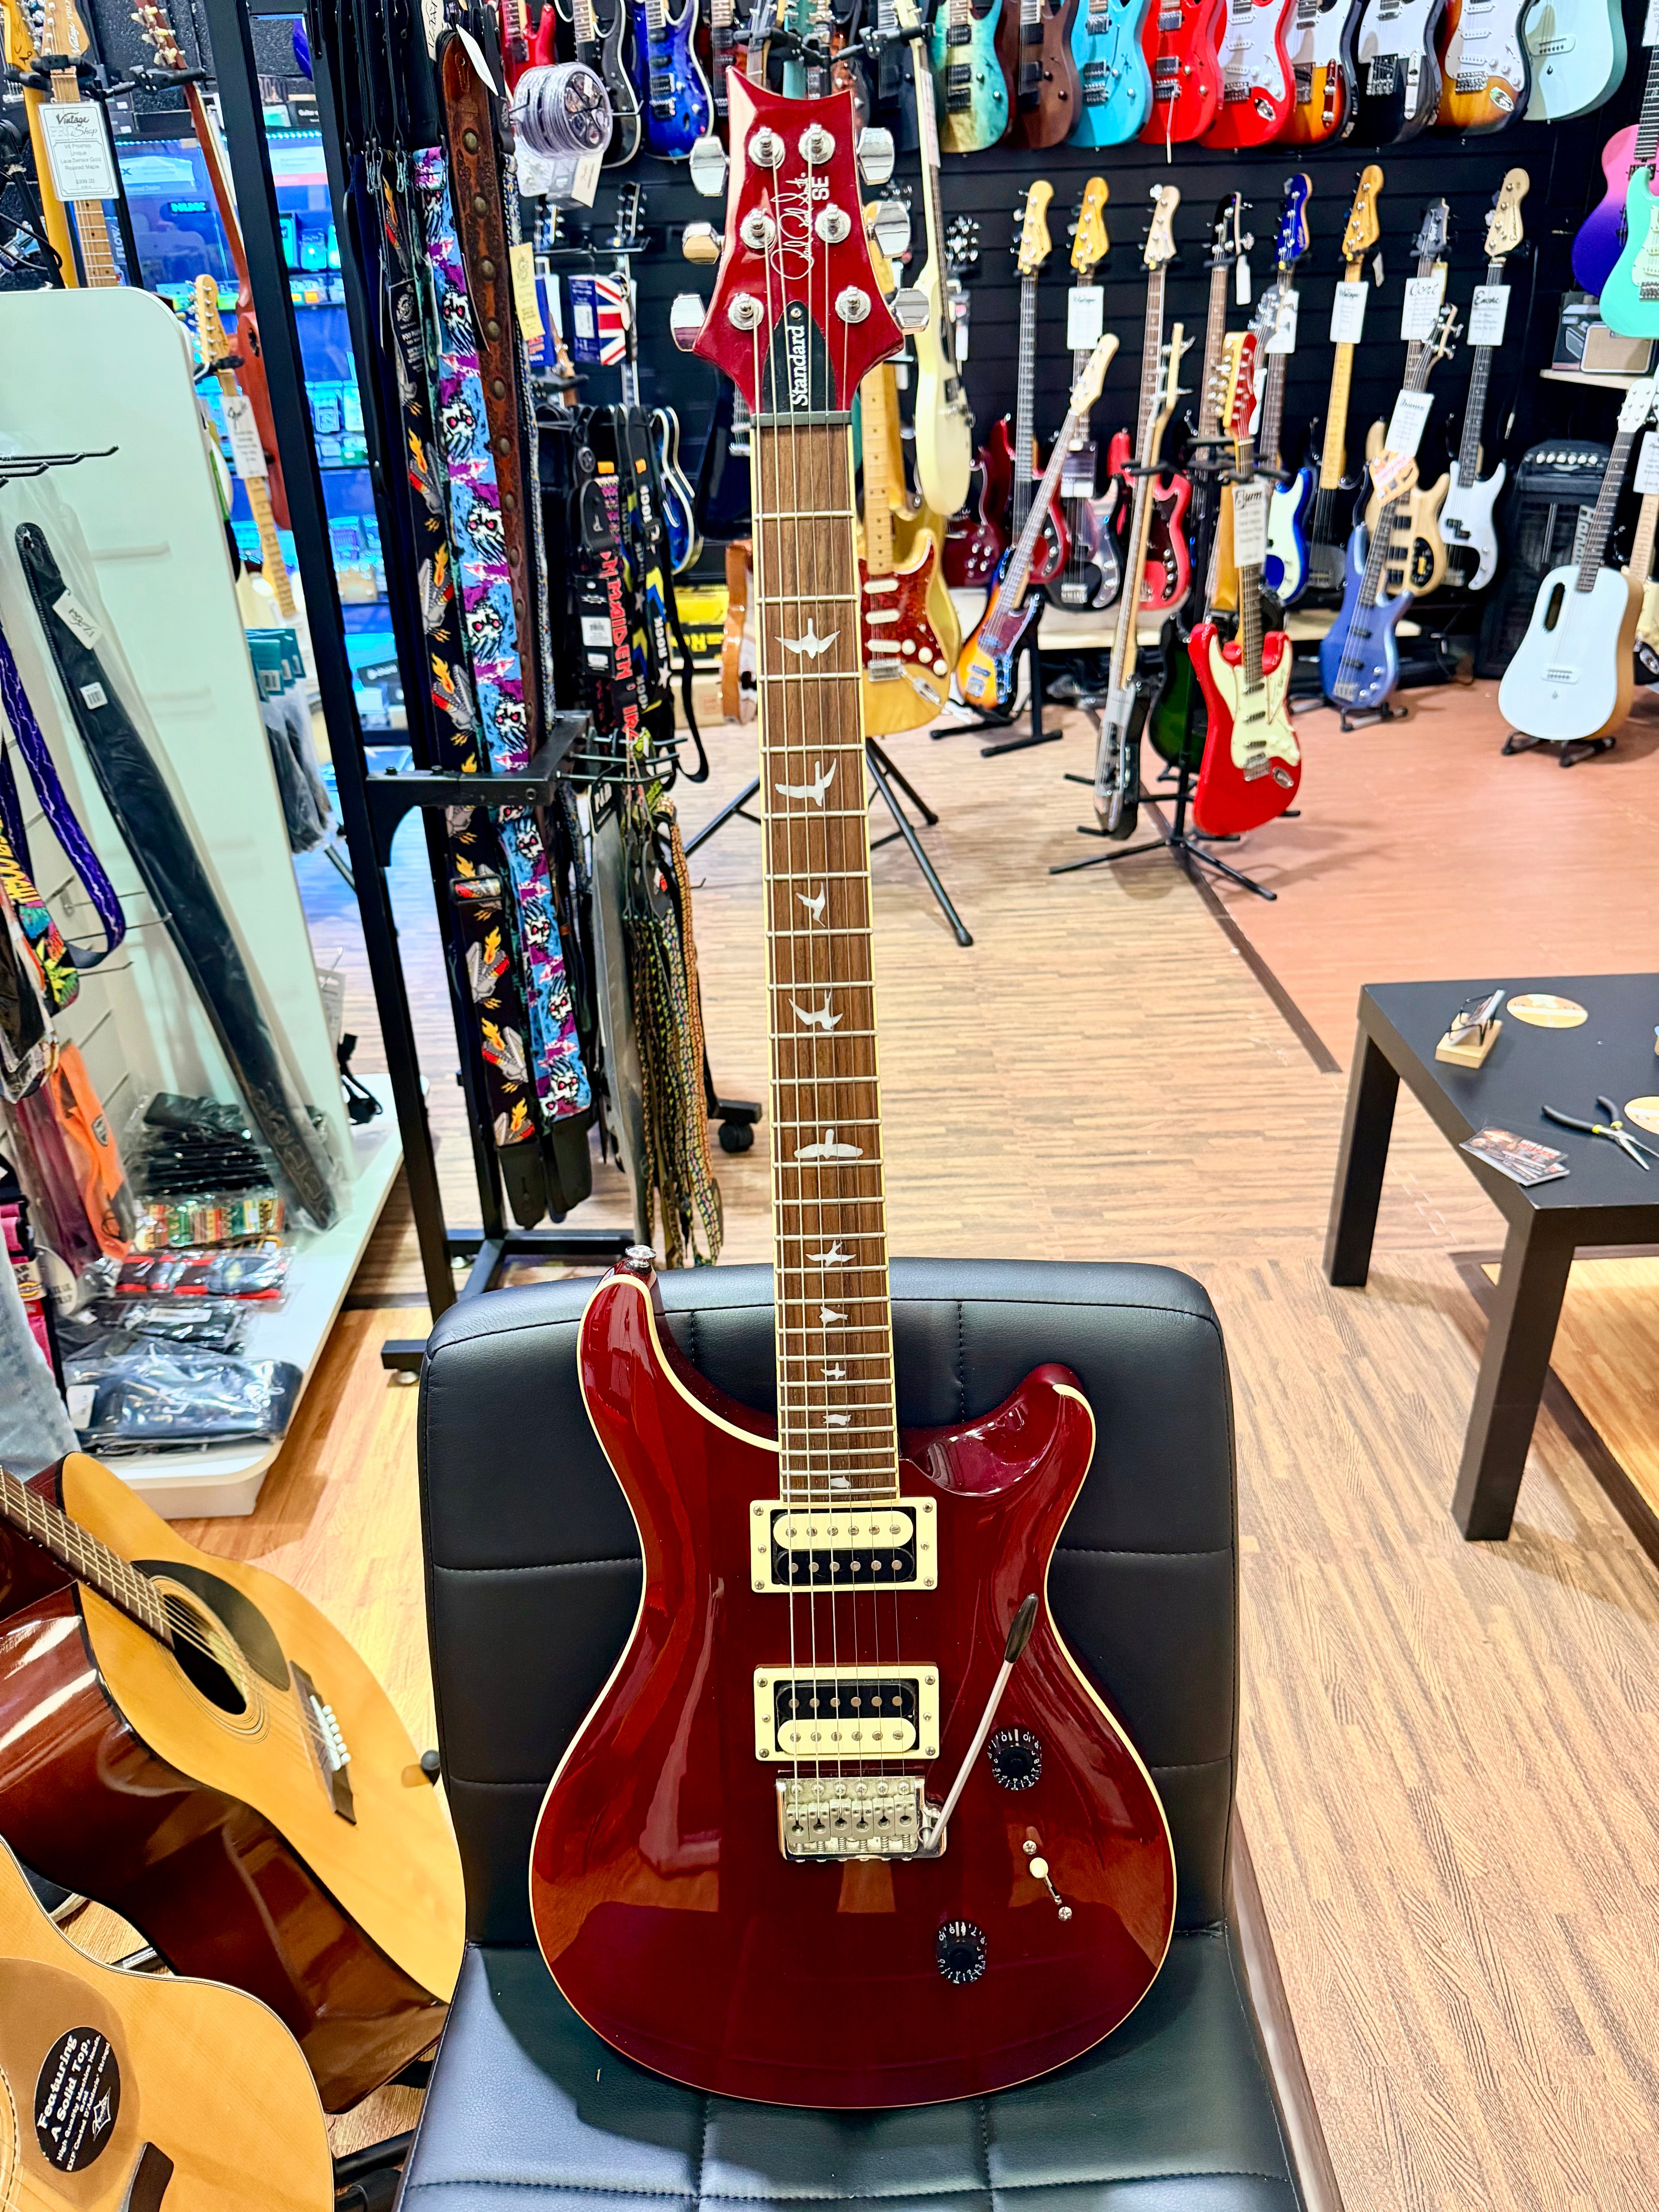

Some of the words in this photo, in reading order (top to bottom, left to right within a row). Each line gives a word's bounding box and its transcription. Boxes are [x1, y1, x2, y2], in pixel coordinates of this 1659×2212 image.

[56, 112, 89, 126] Vintage
[811, 176, 830, 200] SE
[787, 325, 808, 406] Standard
[606, 577, 633, 681] MAIDEN
[654, 616, 668, 659] ROCK
[37, 2035, 77, 2129] Featuring
[51, 2127, 62, 2142] A
[57, 2077, 77, 2122] Solid
[72, 2039, 91, 2073] Top,
[80, 2091, 89, 2112] and
[57, 2140, 68, 2161] High
[65, 2103, 80, 2136] Quality
[76, 2066, 91, 2102] Machine
[74, 2119, 86, 2150] Coated
